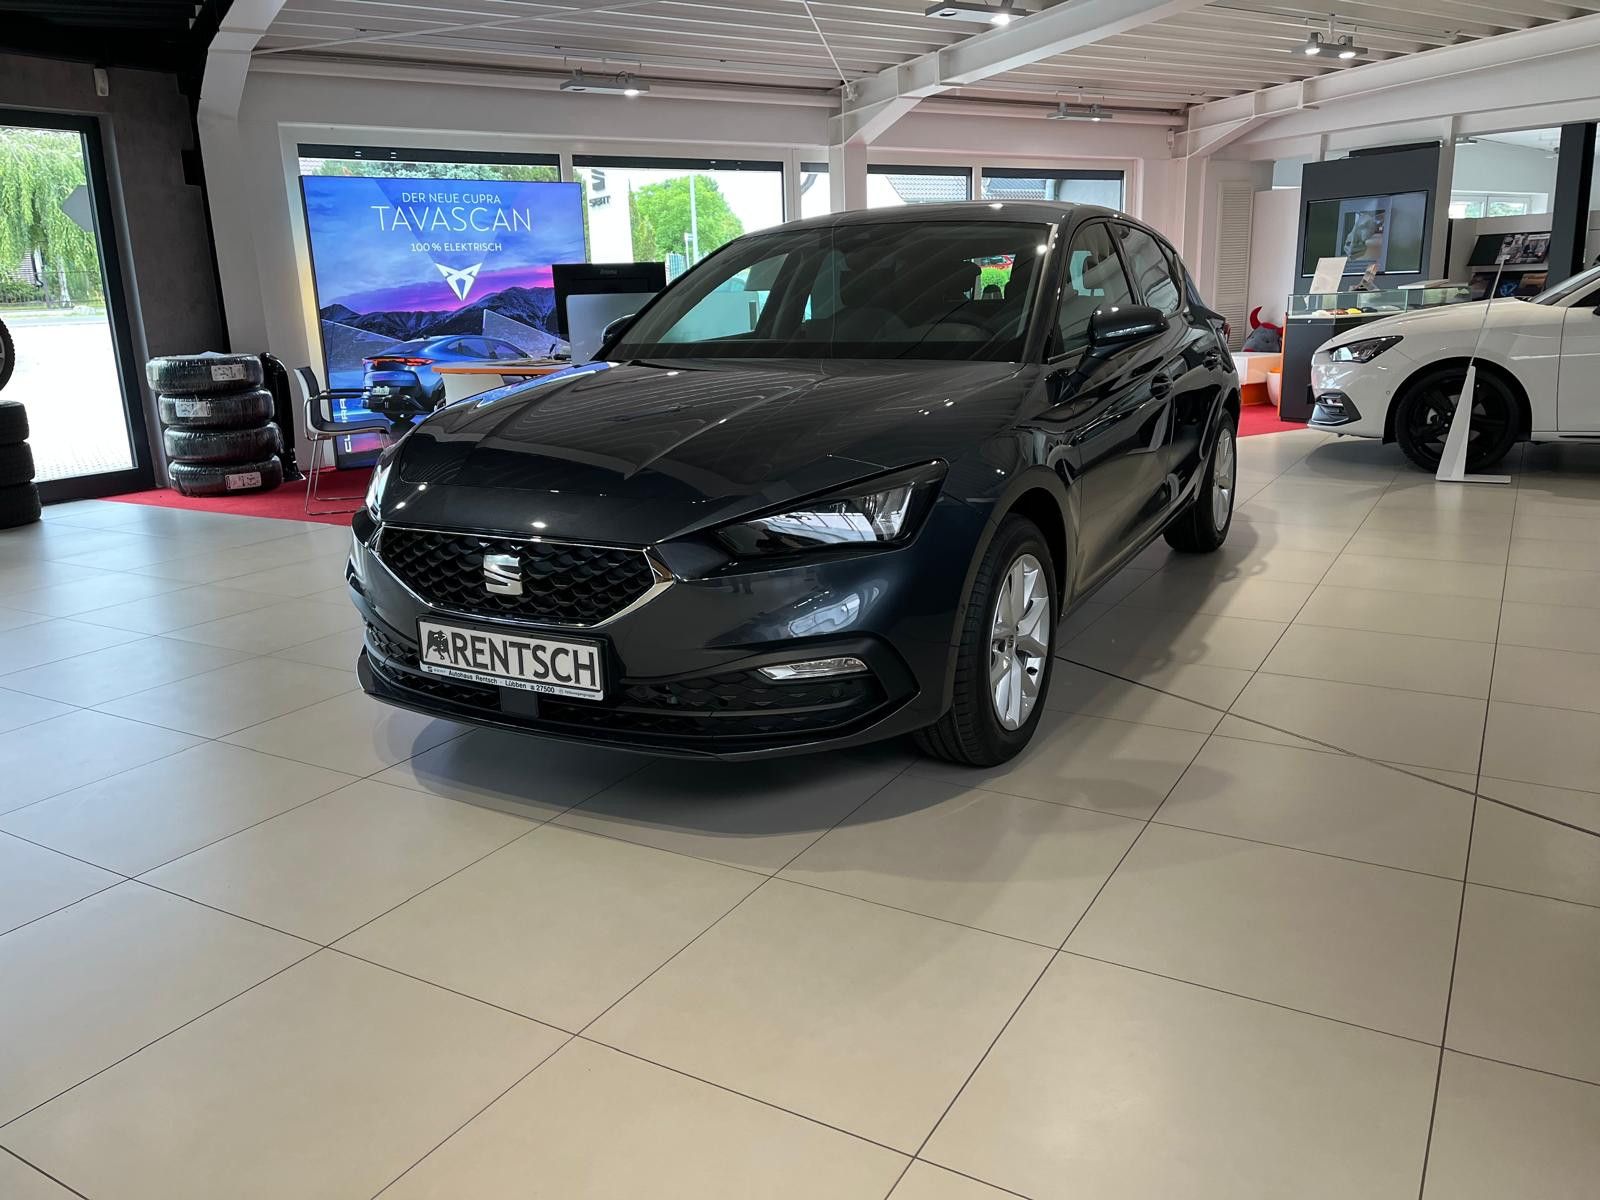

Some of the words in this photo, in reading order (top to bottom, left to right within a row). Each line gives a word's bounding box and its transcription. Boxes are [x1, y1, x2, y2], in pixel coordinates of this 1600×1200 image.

[402, 192, 426, 203] DER
[429, 193, 460, 204] NEUE
[462, 193, 502, 204] CUPRA
[370, 205, 532, 232] TAVASCAN
[444, 242, 502, 252] ELEKTRISCH
[451, 631, 598, 687] RENTSCH
[448, 669, 473, 681] Autohaus
[475, 674, 498, 685] Rentsch
[504, 678, 527, 690] Lübben
[535, 684, 555, 694] 27500
